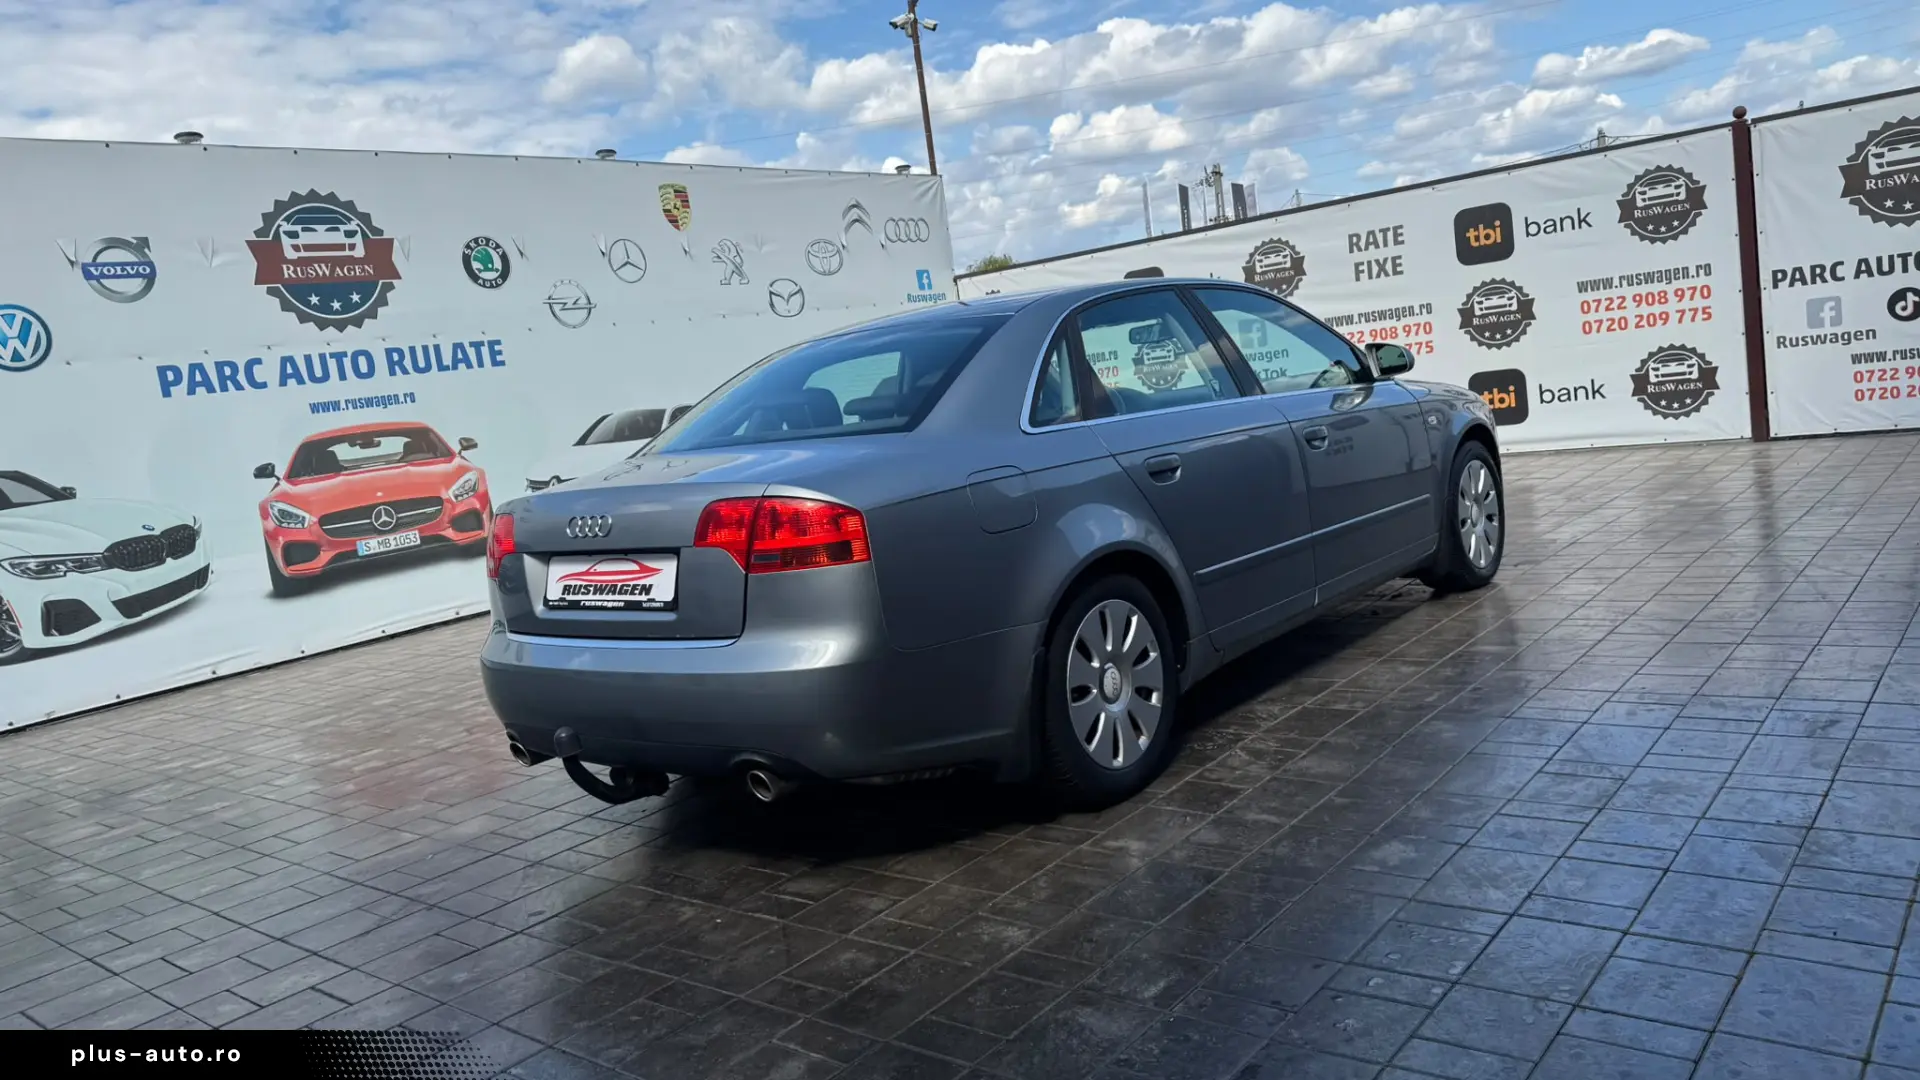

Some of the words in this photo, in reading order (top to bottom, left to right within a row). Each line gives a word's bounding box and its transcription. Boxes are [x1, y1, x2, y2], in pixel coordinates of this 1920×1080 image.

[1466, 220, 1502, 247] tbi
[1524, 207, 1593, 238] bank
[1347, 225, 1406, 255] RATE
[88, 264, 151, 277] VOLVO
[1353, 255, 1405, 283] FIXE
[1576, 262, 1712, 294] www.ruswagen.ro
[1771, 261, 1846, 290] PARC
[477, 278, 502, 288] AUTO
[907, 292, 947, 304] Ruswagen
[1580, 295, 1628, 315] 0722
[1631, 289, 1670, 308] 908
[1673, 284, 1712, 303] 970
[1324, 302, 1433, 328] www.ruswagen.ro
[1581, 316, 1629, 336] 0720
[1633, 311, 1671, 329] 209
[1675, 306, 1713, 325] 775
[1369, 326, 1399, 342] 908
[1402, 321, 1433, 337] 970
[1776, 328, 1877, 350] Ruswagen
[156, 357, 268, 398] PARC
[278, 349, 377, 385] AUTO
[384, 339, 507, 376] RULATE
[1097, 366, 1119, 378] 970
[1853, 367, 1900, 384] 0722
[309, 391, 417, 414] www.ruswagen.ro
[1538, 378, 1607, 405] bank
[1854, 386, 1901, 402] 0720
[393, 532, 418, 547] 1053
[561, 583, 653, 596] RUSWAGEN
